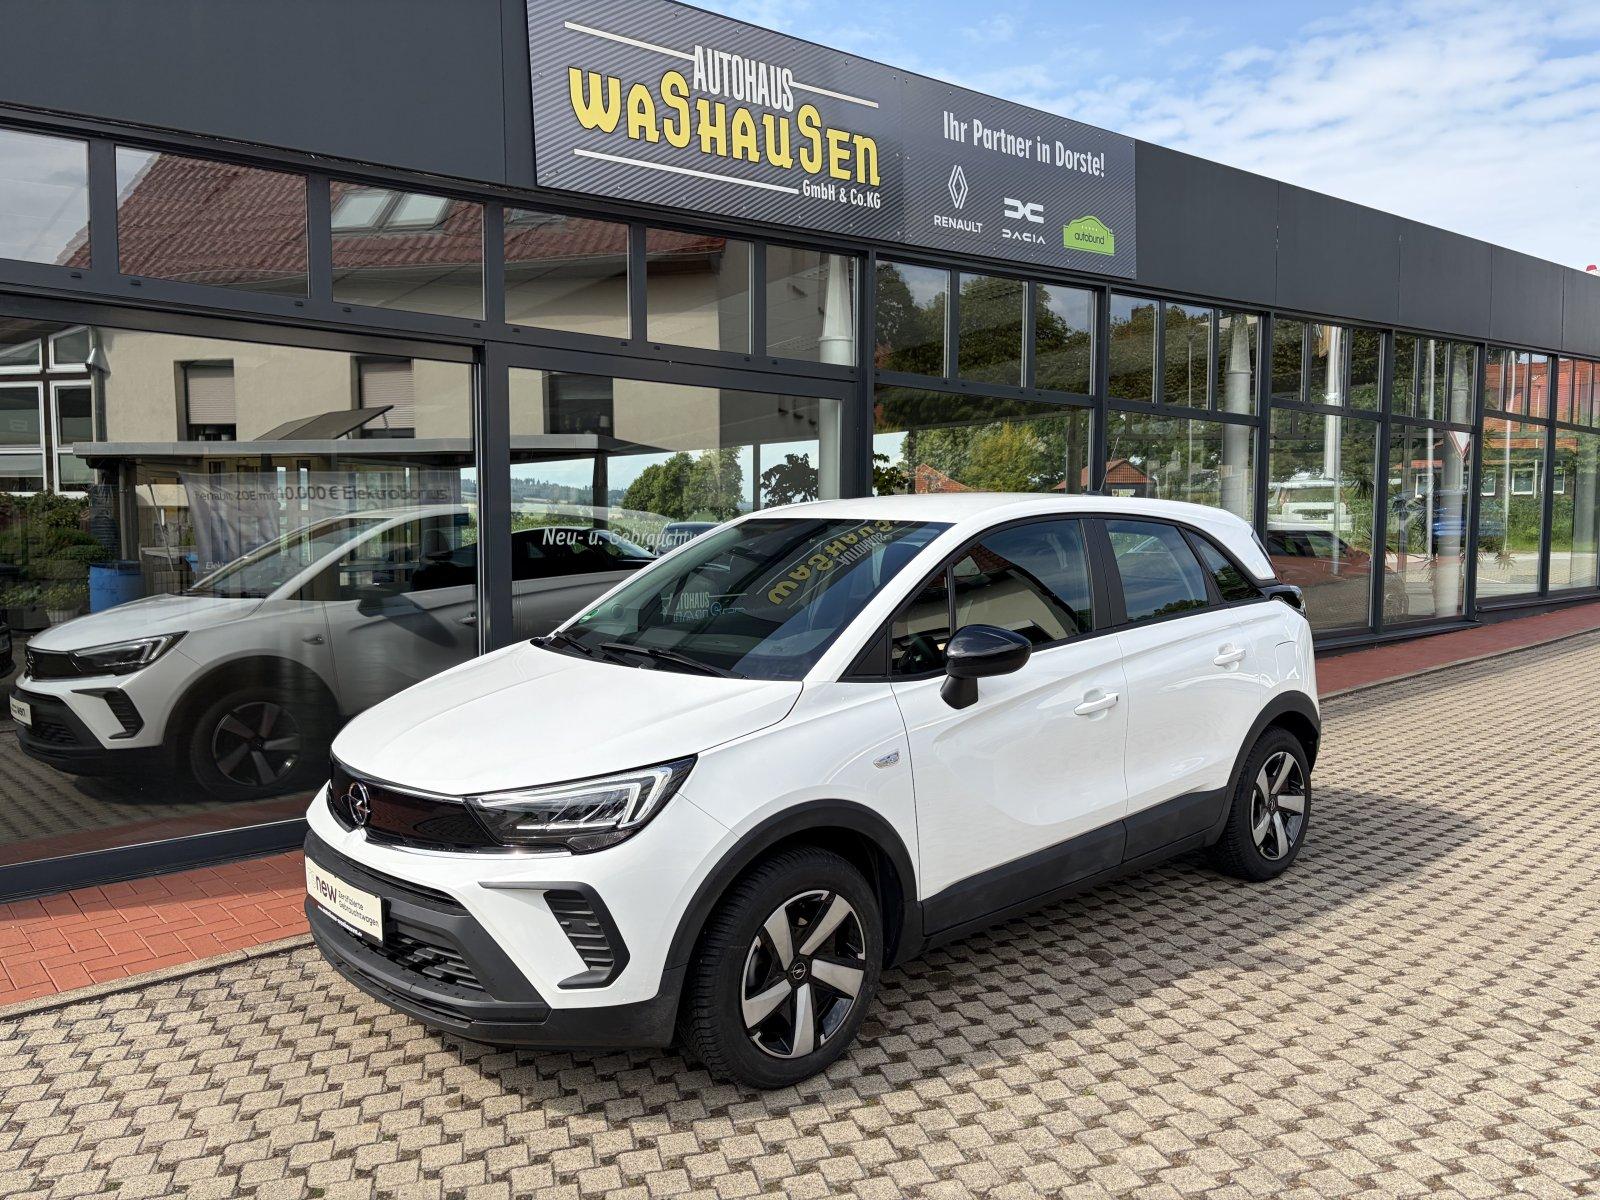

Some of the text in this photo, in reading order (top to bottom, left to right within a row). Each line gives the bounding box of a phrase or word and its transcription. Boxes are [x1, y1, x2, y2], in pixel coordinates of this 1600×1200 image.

[693, 45, 794, 112] AUTOHAUS
[943, 110, 1105, 178] Ihr Partner in Dorste!
[802, 179, 881, 209] GmbH & Co.KG
[933, 214, 983, 233] RENAULT
[1001, 228, 1046, 245] DACIA
[1074, 231, 1105, 245] autobund
[329, 485, 339, 500] €
[542, 528, 583, 546] Neu-
[588, 529, 603, 546] u.
